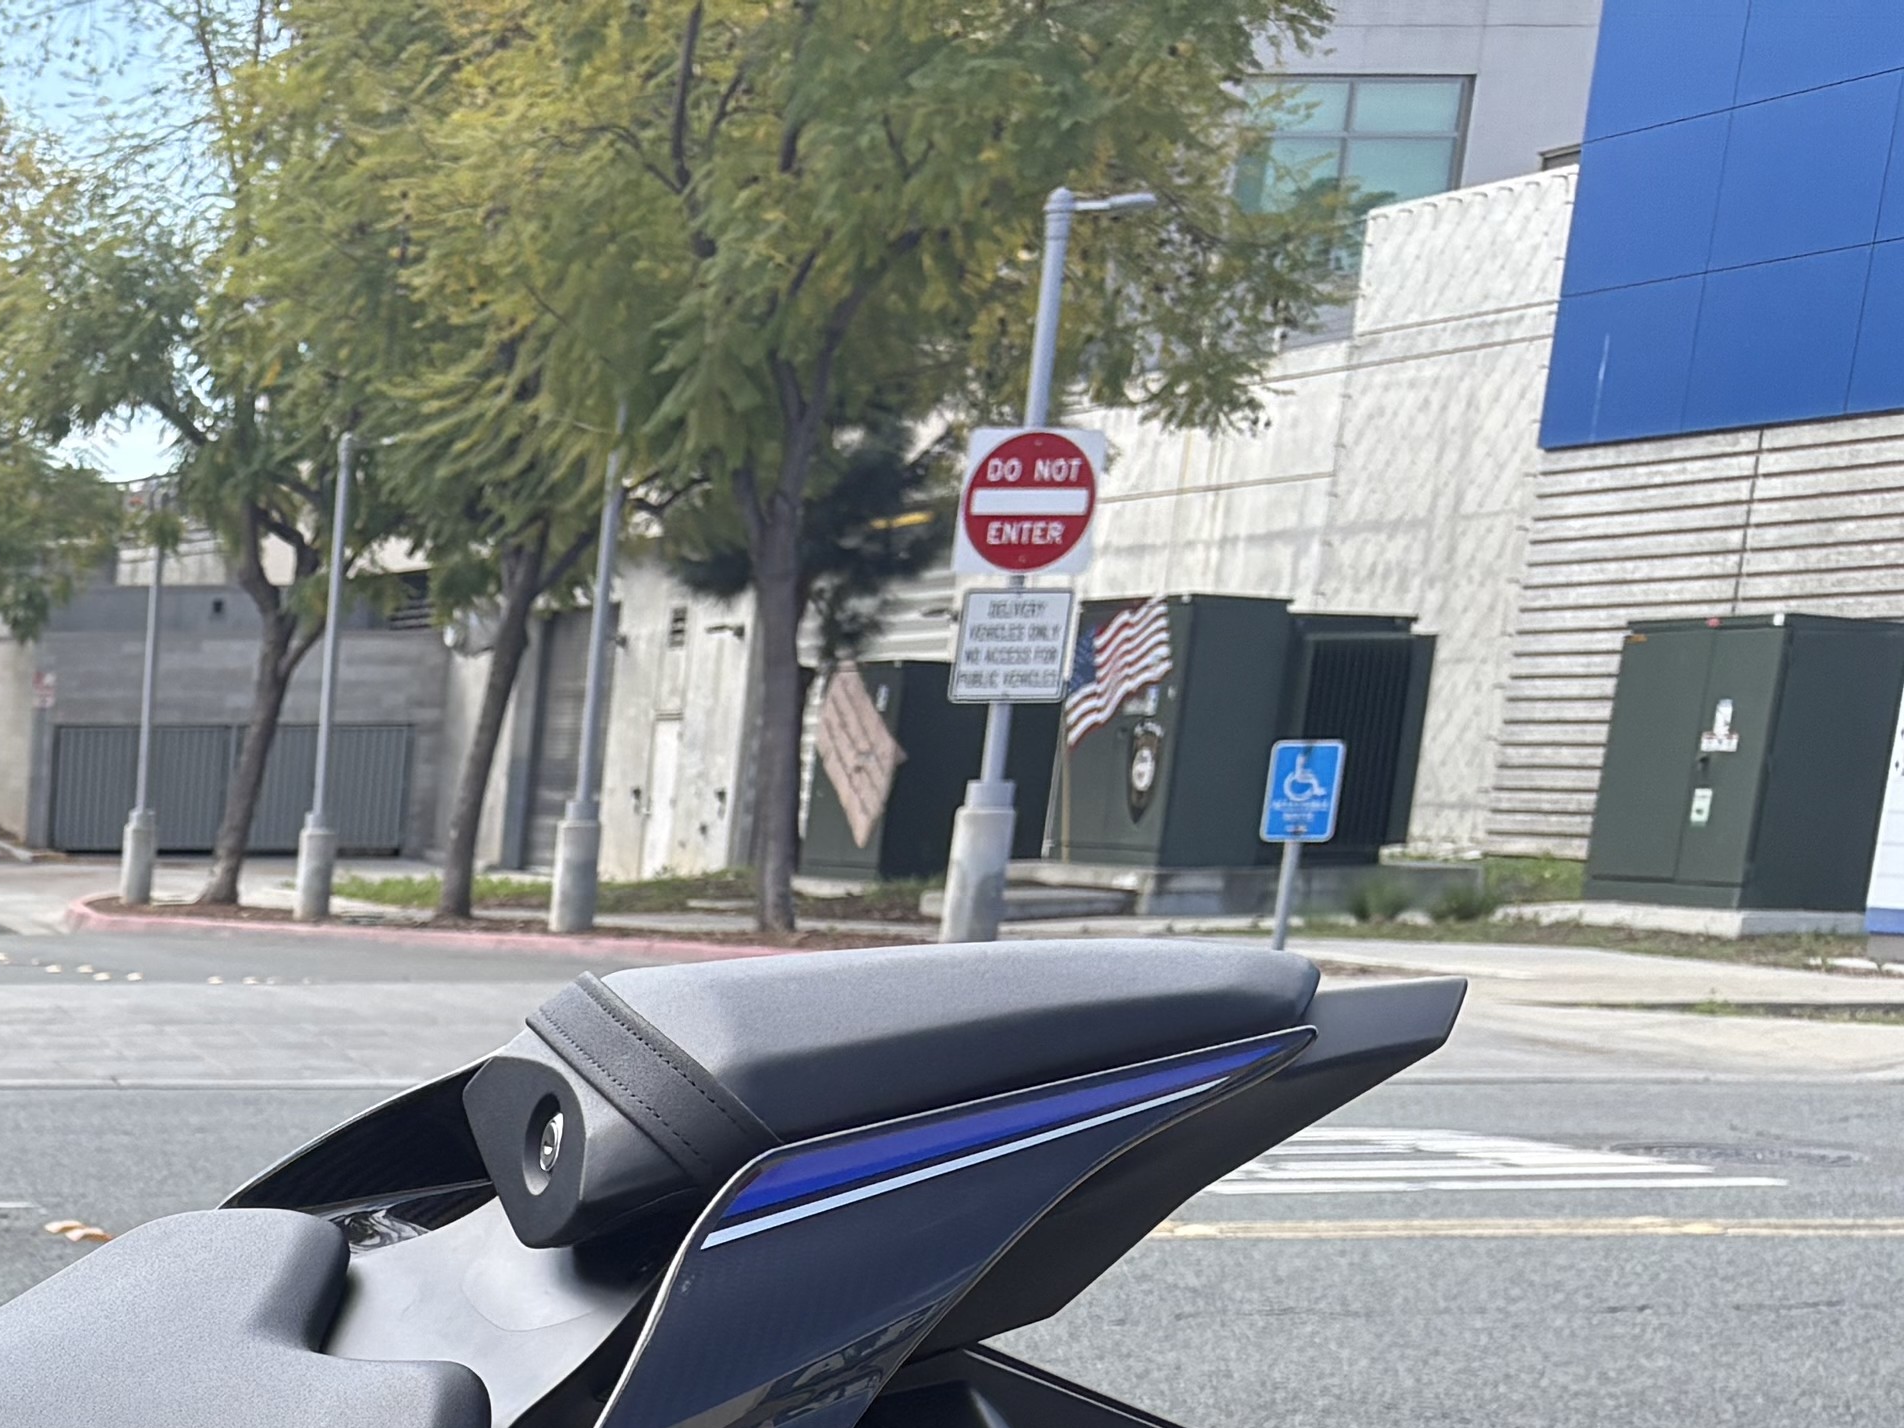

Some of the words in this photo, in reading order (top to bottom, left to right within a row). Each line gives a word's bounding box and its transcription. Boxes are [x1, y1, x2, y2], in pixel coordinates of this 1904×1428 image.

[986, 457, 1022, 482] DO
[1033, 457, 1082, 482] NOT
[986, 520, 1066, 546] ENTER
